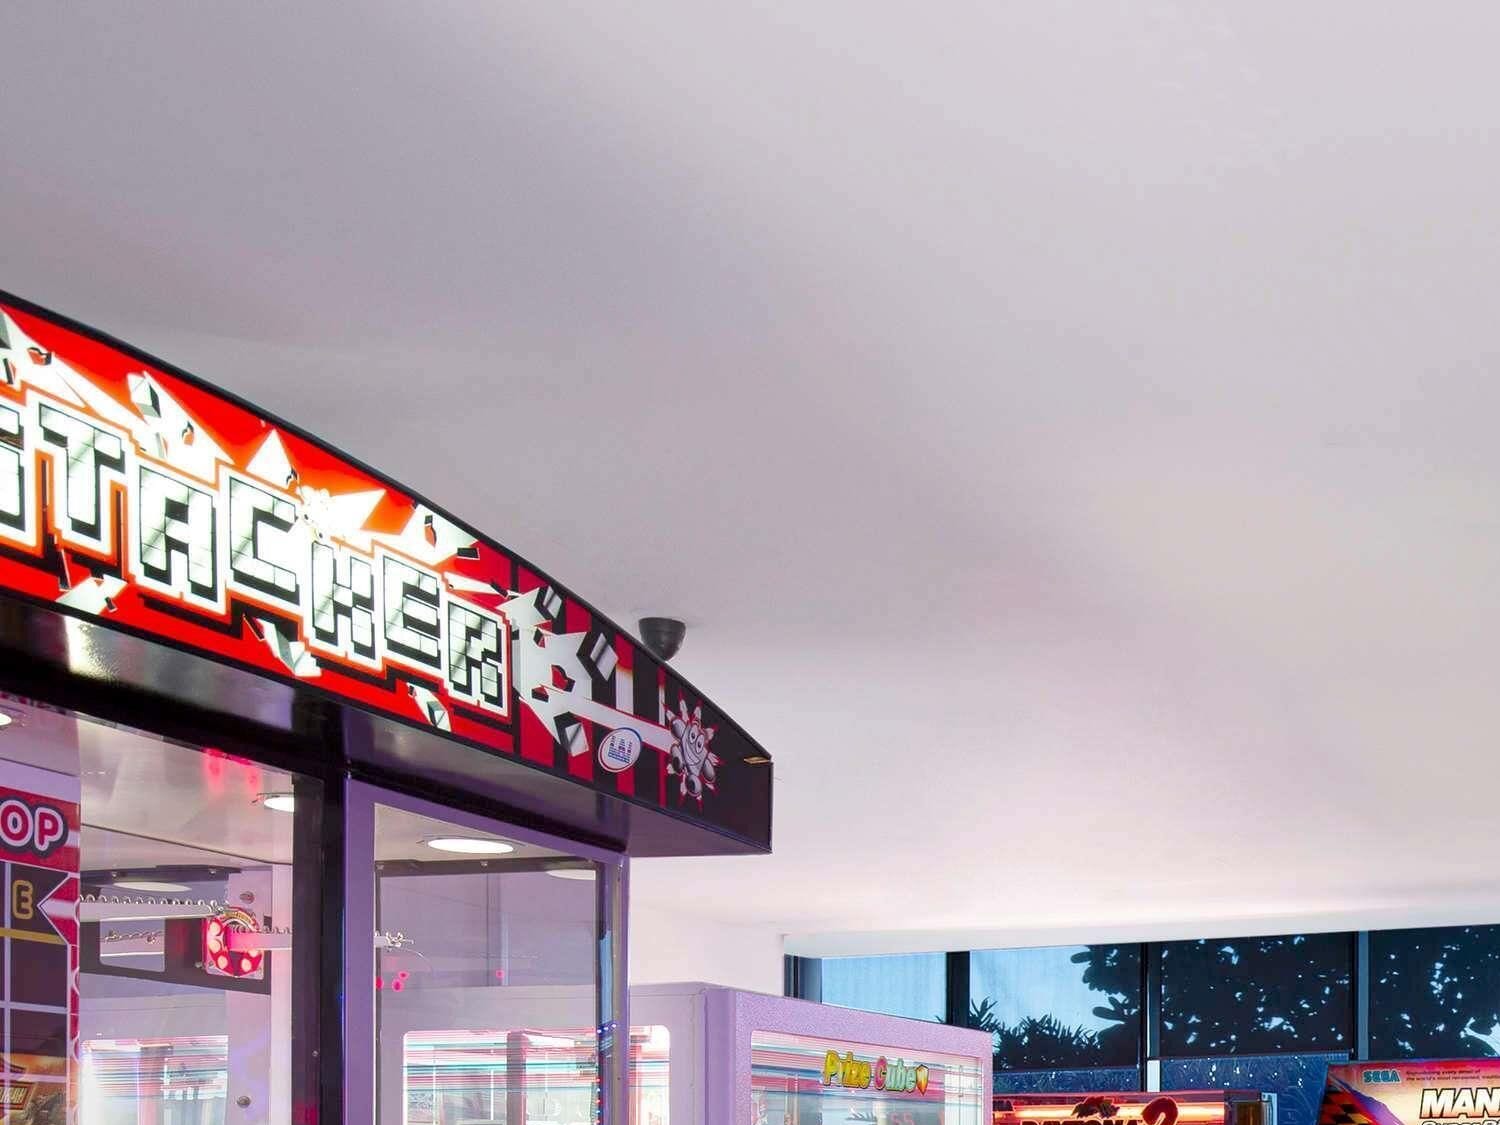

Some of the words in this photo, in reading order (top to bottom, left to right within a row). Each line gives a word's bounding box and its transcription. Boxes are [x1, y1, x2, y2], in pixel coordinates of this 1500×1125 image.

[0, 402, 503, 708] TACKER
[823, 1049, 872, 1089] Prize
[874, 1055, 918, 1093] Cube
[1363, 1070, 1400, 1083] SEGA
